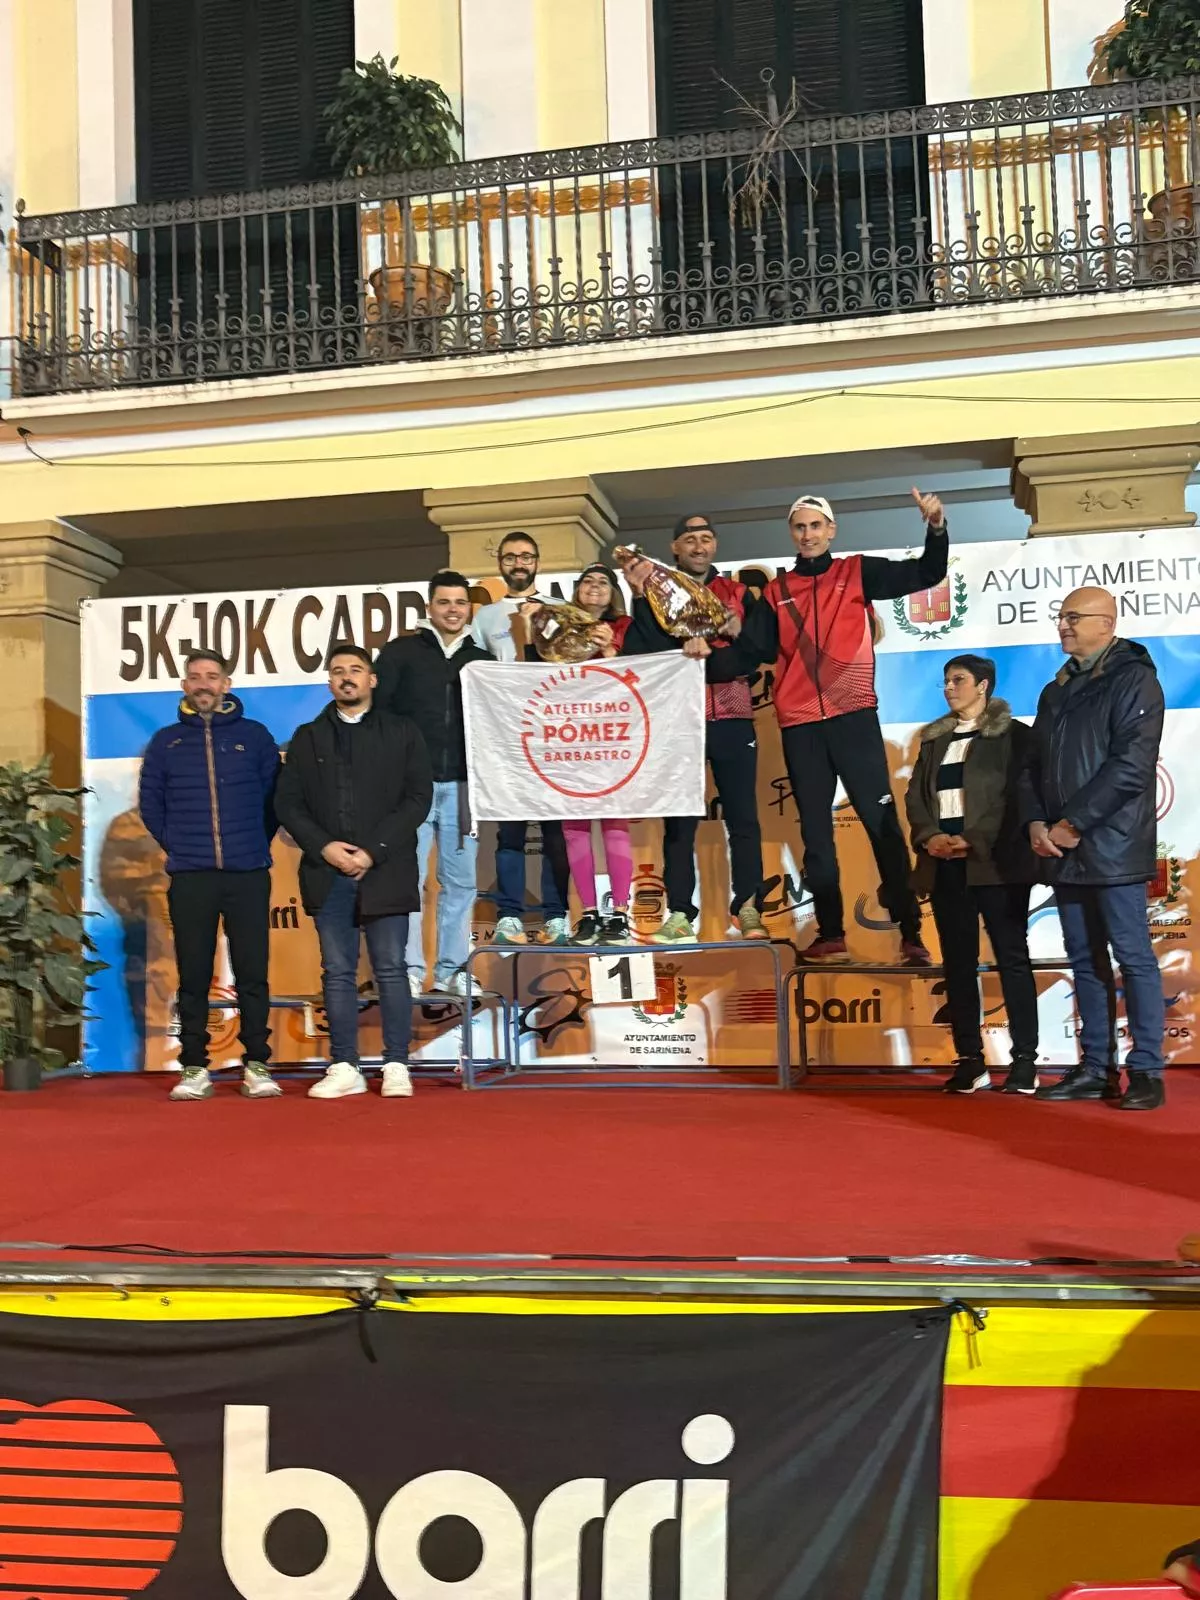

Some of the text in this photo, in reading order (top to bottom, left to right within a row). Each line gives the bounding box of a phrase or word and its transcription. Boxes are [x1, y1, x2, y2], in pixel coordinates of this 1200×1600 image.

[981, 557, 1200, 593] AYUNTAMIENT
[997, 590, 1200, 625] DE SÑENA
[119, 598, 278, 682] 5K-10K
[543, 701, 631, 716] ATLETISMO
[543, 717, 631, 743] PÓMEZ
[544, 750, 631, 762] BARBASTRO
[607, 956, 633, 1000] 1
[794, 988, 881, 1024] barri
[624, 1034, 697, 1042] AYUNTAMIENTO
[629, 1046, 642, 1054] DE
[221, 1404, 735, 1600] barri
